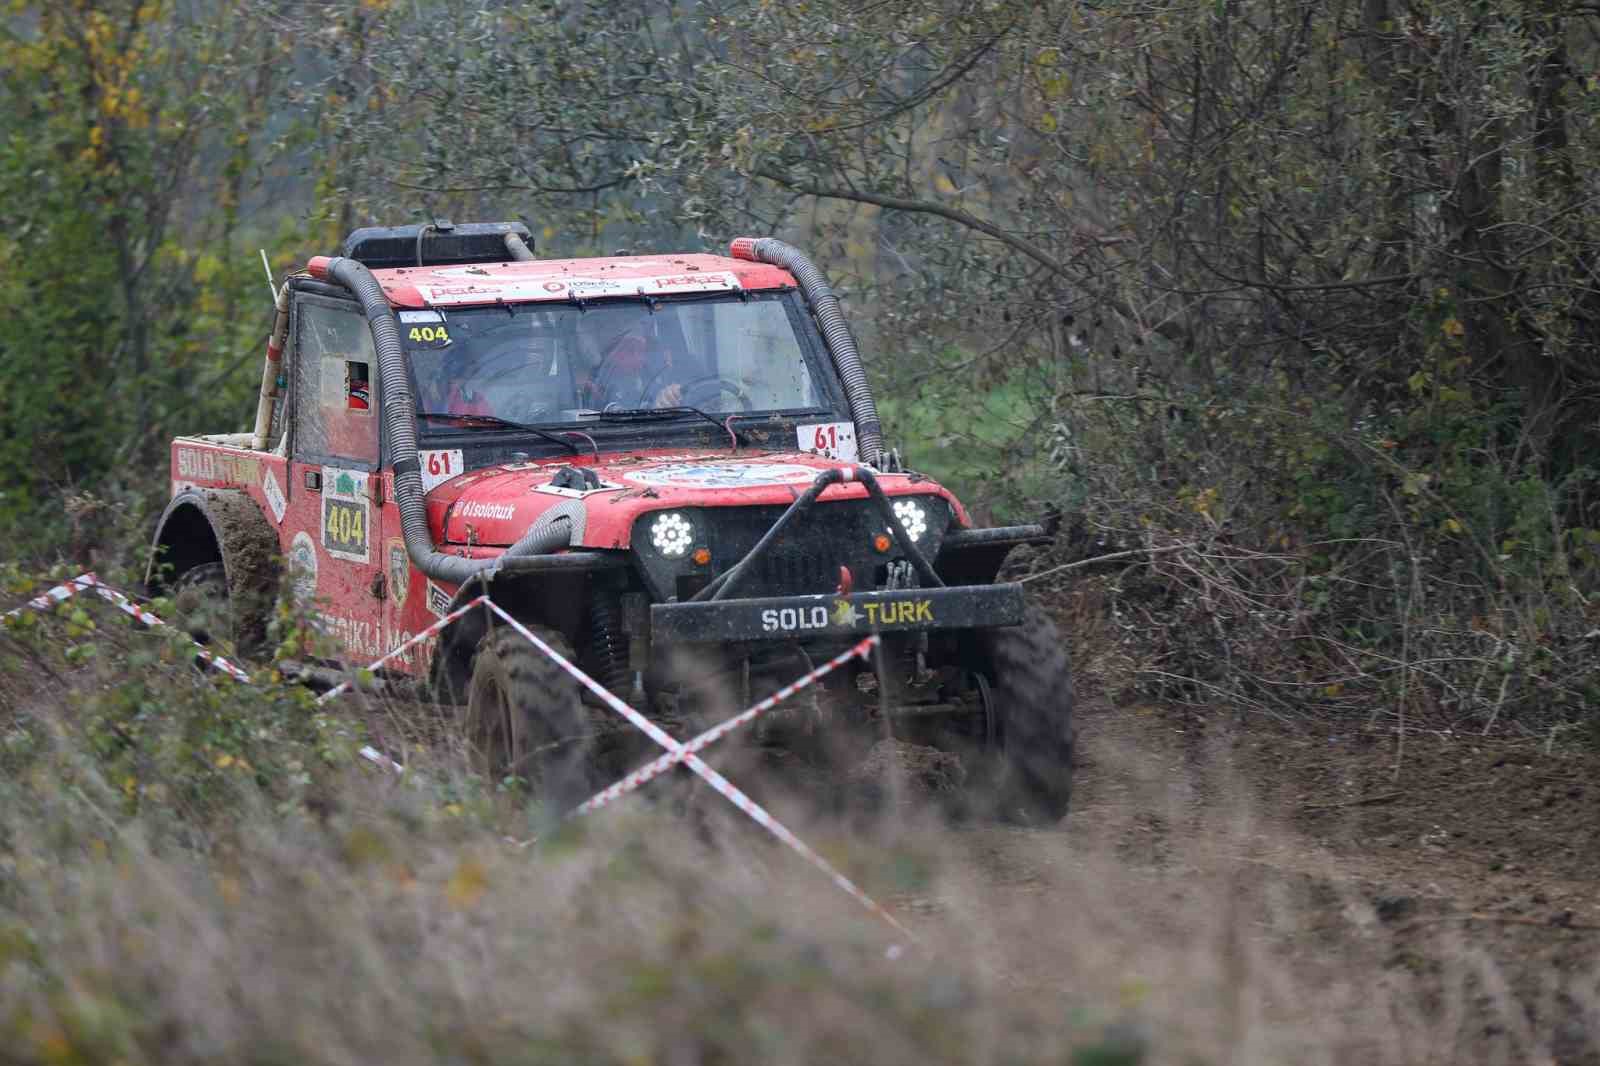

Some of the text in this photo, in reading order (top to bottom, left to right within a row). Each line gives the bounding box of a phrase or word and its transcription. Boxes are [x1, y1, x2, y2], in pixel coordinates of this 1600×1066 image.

[408, 326, 449, 342] 404
[814, 425, 837, 449] 61
[428, 452, 450, 476] 61
[327, 504, 364, 546] 404
[761, 600, 934, 632] SOLO TURK
